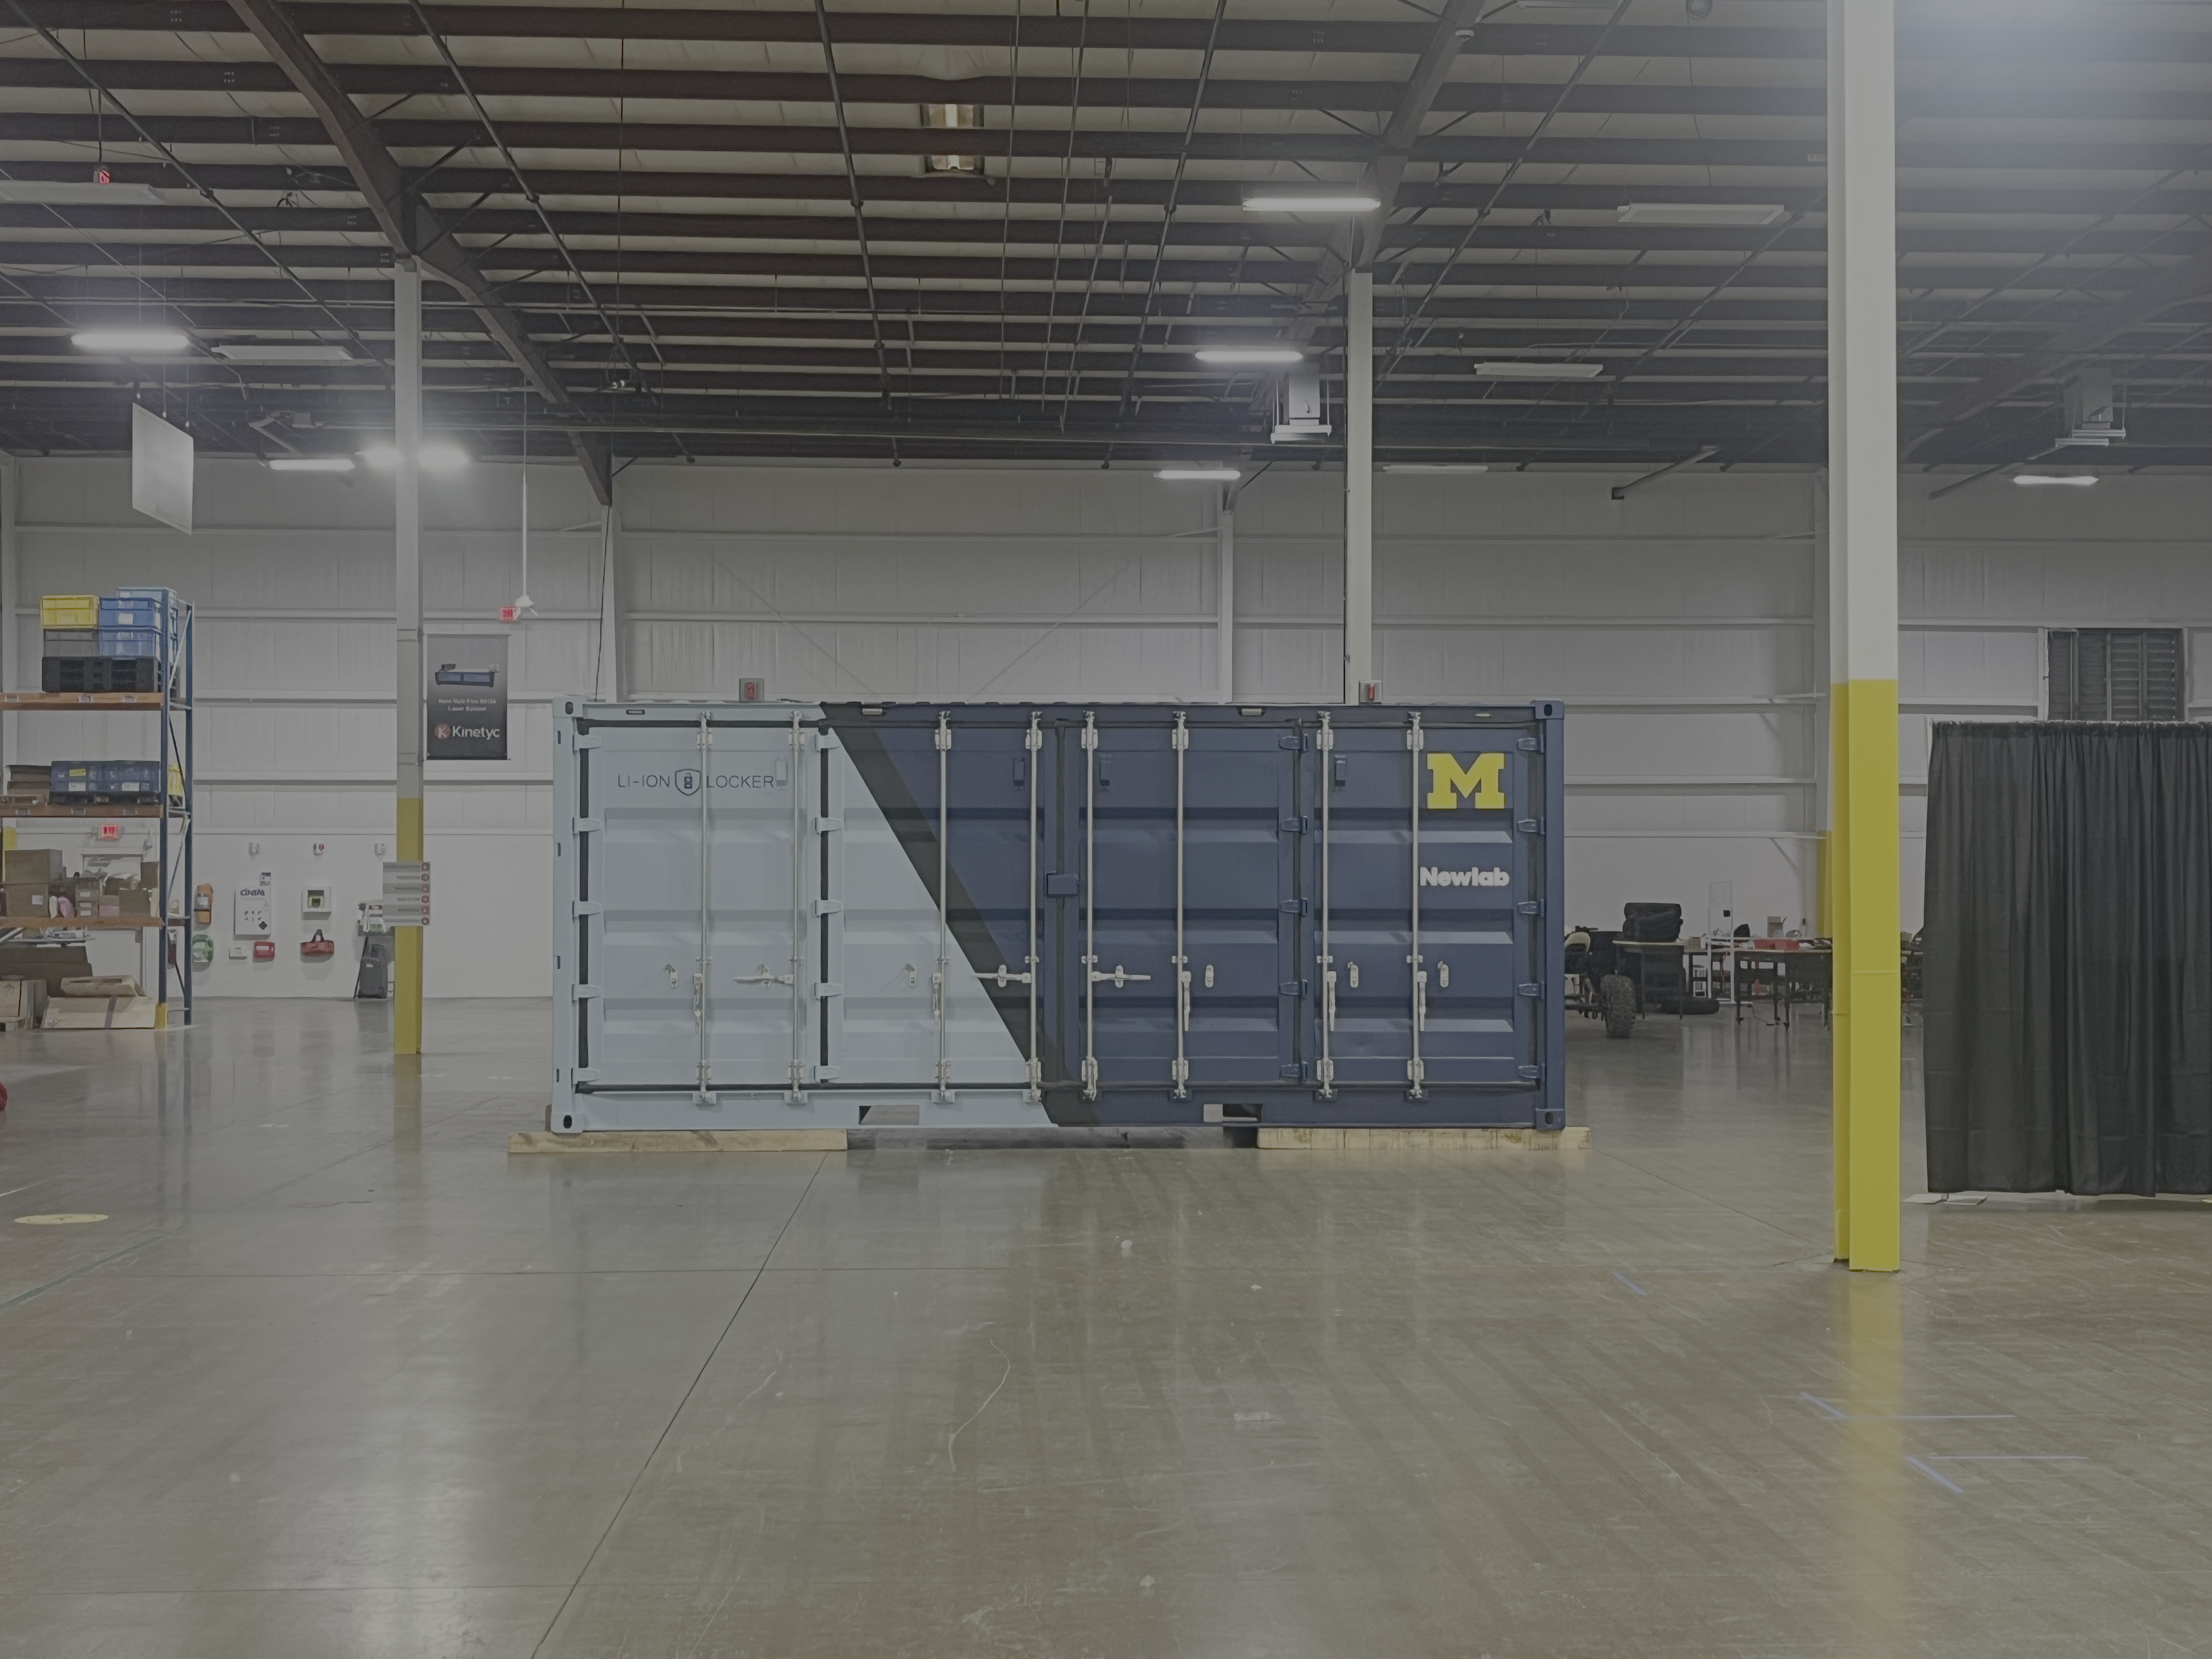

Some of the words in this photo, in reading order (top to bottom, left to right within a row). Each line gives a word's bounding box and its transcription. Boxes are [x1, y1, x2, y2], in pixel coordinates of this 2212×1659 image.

[452, 725, 500, 741] Kinetyc
[618, 774, 670, 788] LI-ION
[706, 775, 774, 788] LOCKER
[1426, 752, 1505, 810] M
[1419, 866, 1510, 887] Newlab
